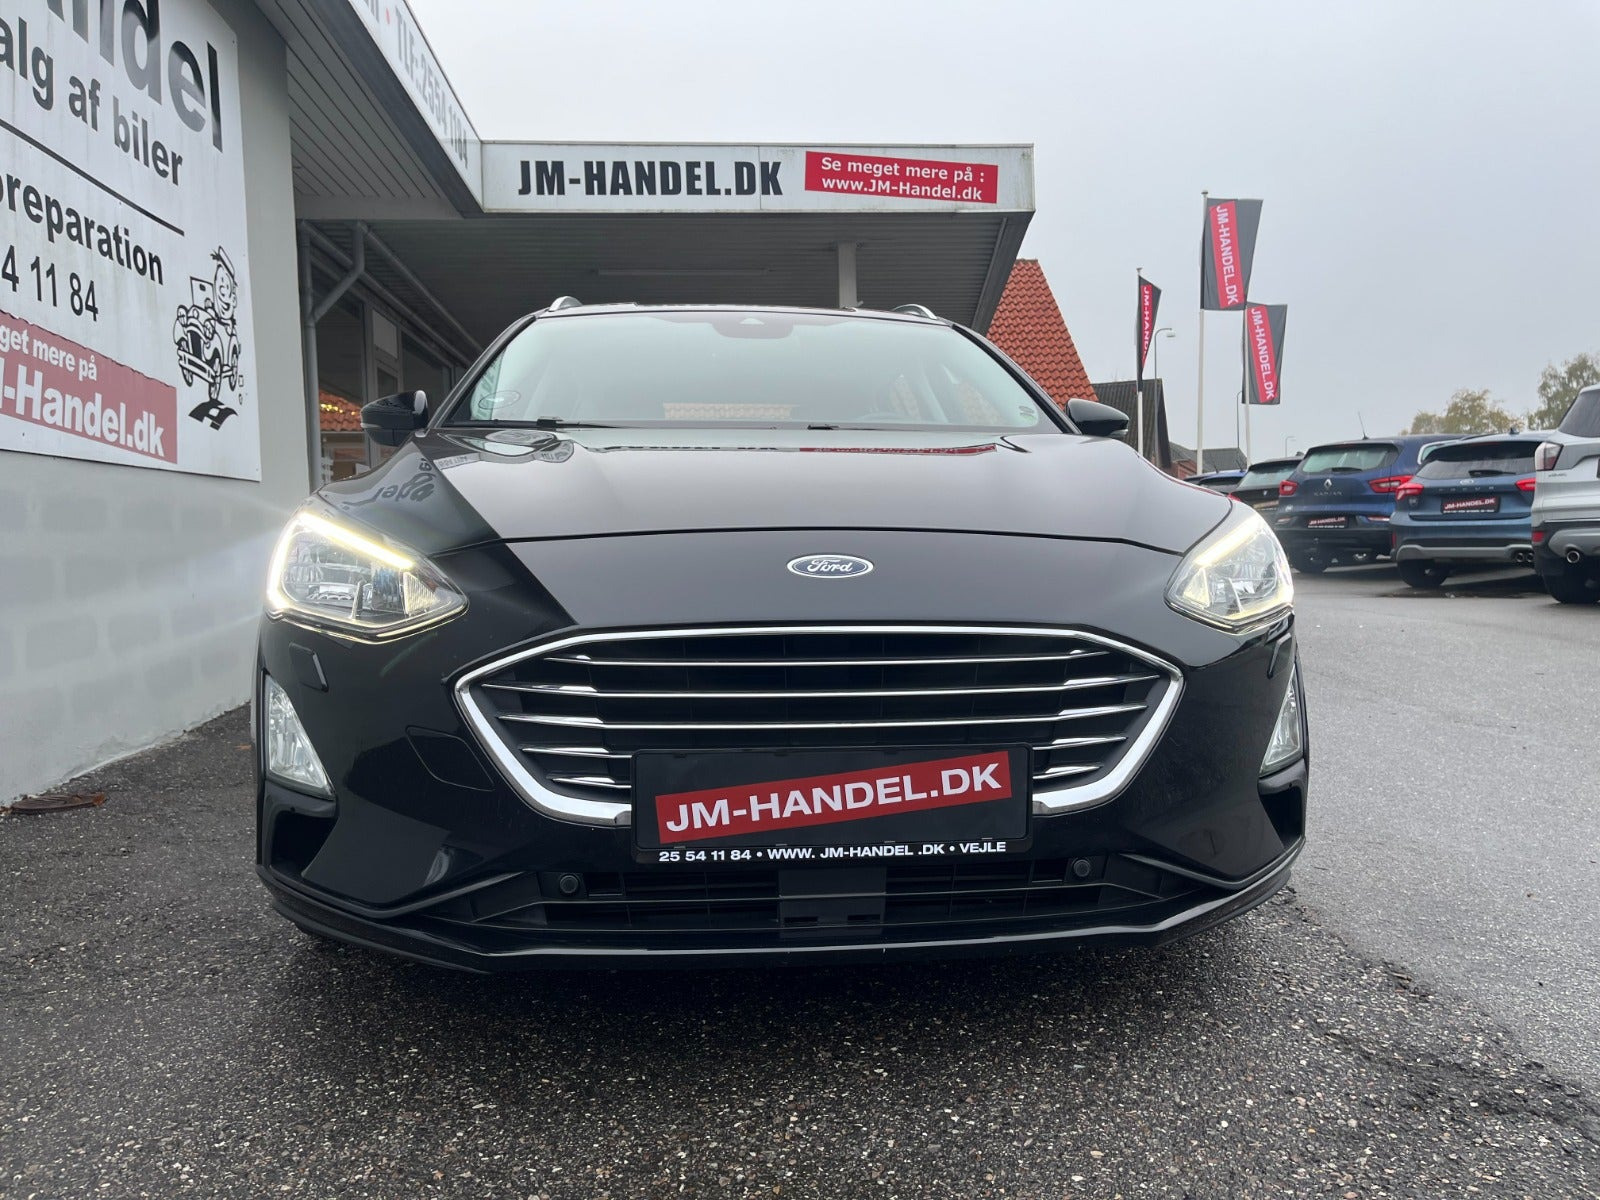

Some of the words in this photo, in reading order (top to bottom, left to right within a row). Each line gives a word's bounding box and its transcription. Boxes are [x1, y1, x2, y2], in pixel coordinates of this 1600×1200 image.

[69, 75, 101, 132] af
[113, 95, 183, 186] biler
[518, 160, 783, 197] JM-HANDEL.DK
[821, 156, 842, 171] Se
[847, 159, 900, 178] meget
[905, 165, 948, 180] mere
[953, 167, 973, 184] på
[822, 177, 982, 201] www.JM-Handel.dk
[0, 173, 164, 286] reparation
[1216, 205, 1239, 305] JM-HANDEL.DK
[30, 256, 58, 308] 11
[69, 272, 99, 322] 84
[33, 338, 76, 372] mere
[78, 355, 97, 381] på
[1251, 307, 1275, 400] JM-HANDEL.DK
[807, 559, 853, 573] Ford
[666, 763, 1002, 832] JM-HANDEL.DK
[659, 851, 680, 862] 25
[685, 850, 707, 861] 54
[711, 850, 725, 861] 11
[730, 850, 751, 861] 84
[767, 848, 815, 860] WWW.
[820, 845, 913, 859] JM-HANDEL
[918, 843, 945, 855] .DK
[959, 841, 1006, 853] VEJLE
